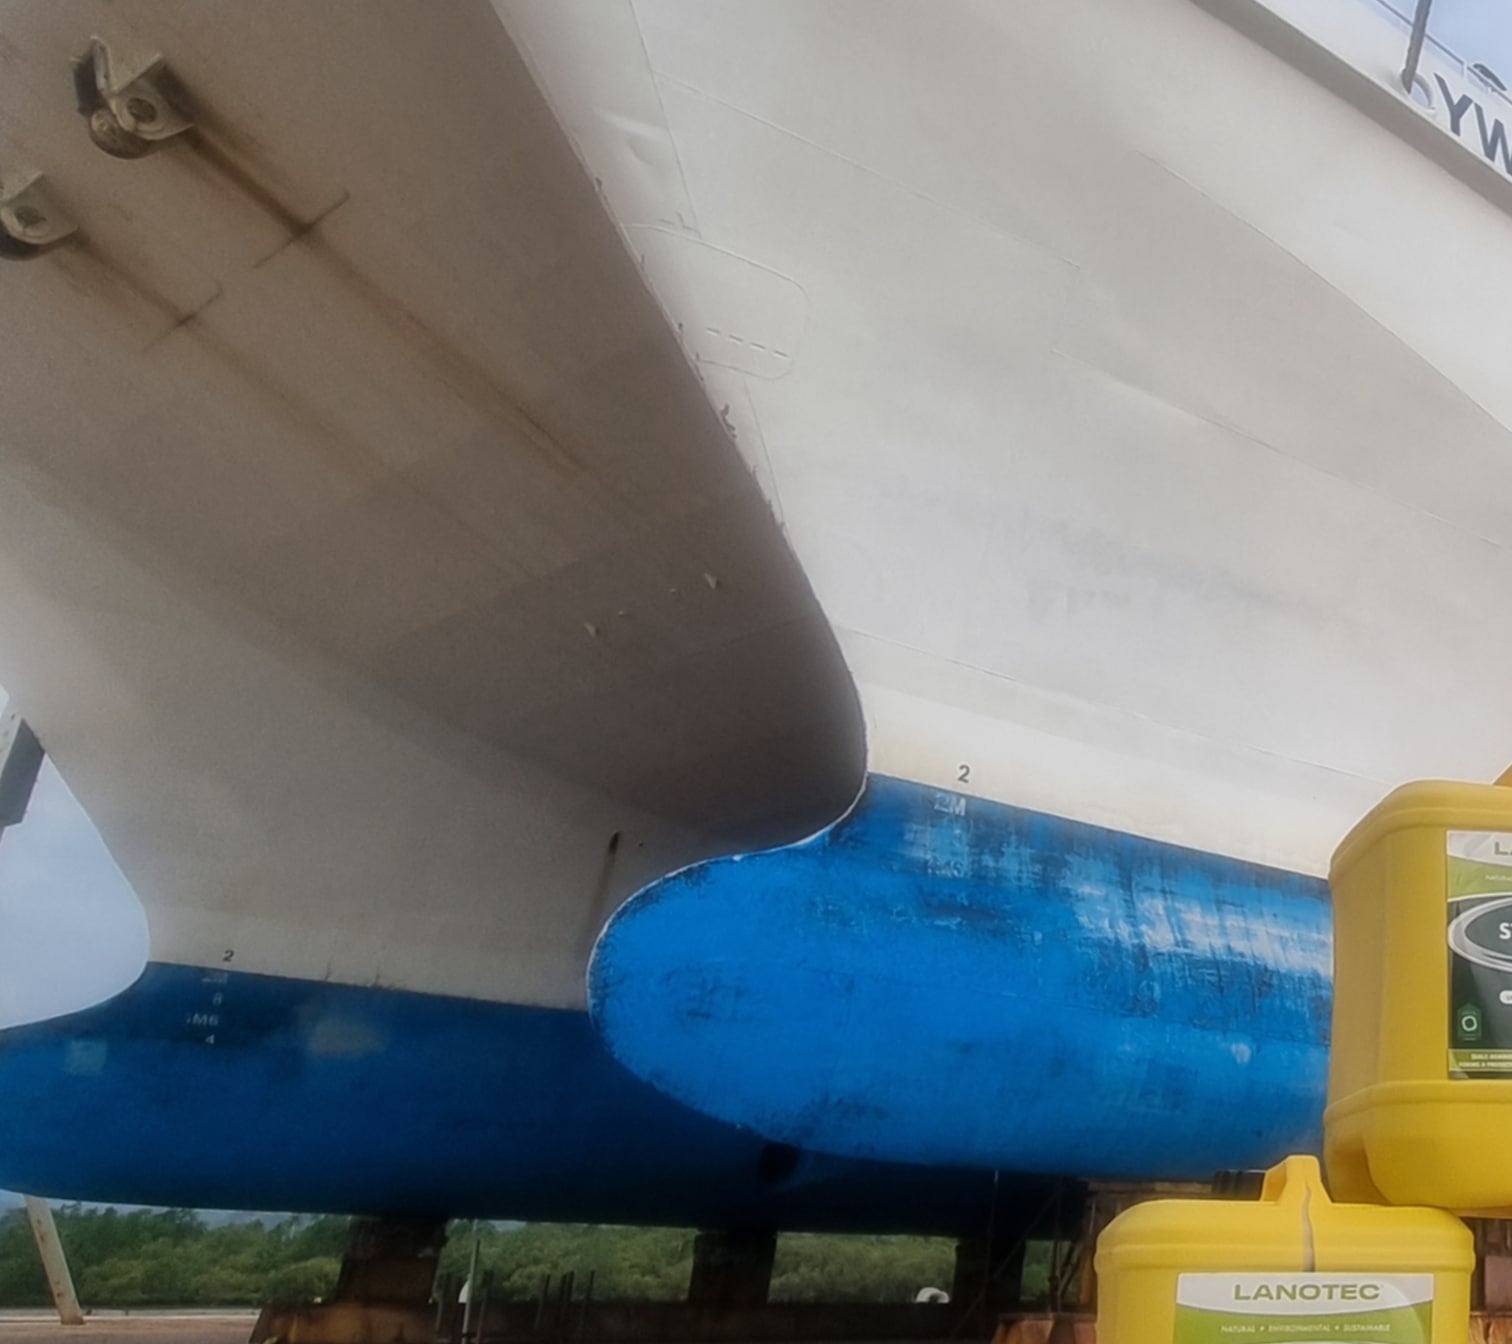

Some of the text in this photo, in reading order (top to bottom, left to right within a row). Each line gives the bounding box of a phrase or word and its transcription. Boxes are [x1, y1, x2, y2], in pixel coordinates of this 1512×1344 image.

[957, 764, 970, 783] 2
[223, 949, 235, 963] 2
[1233, 1284, 1380, 1300] LANOTEC
